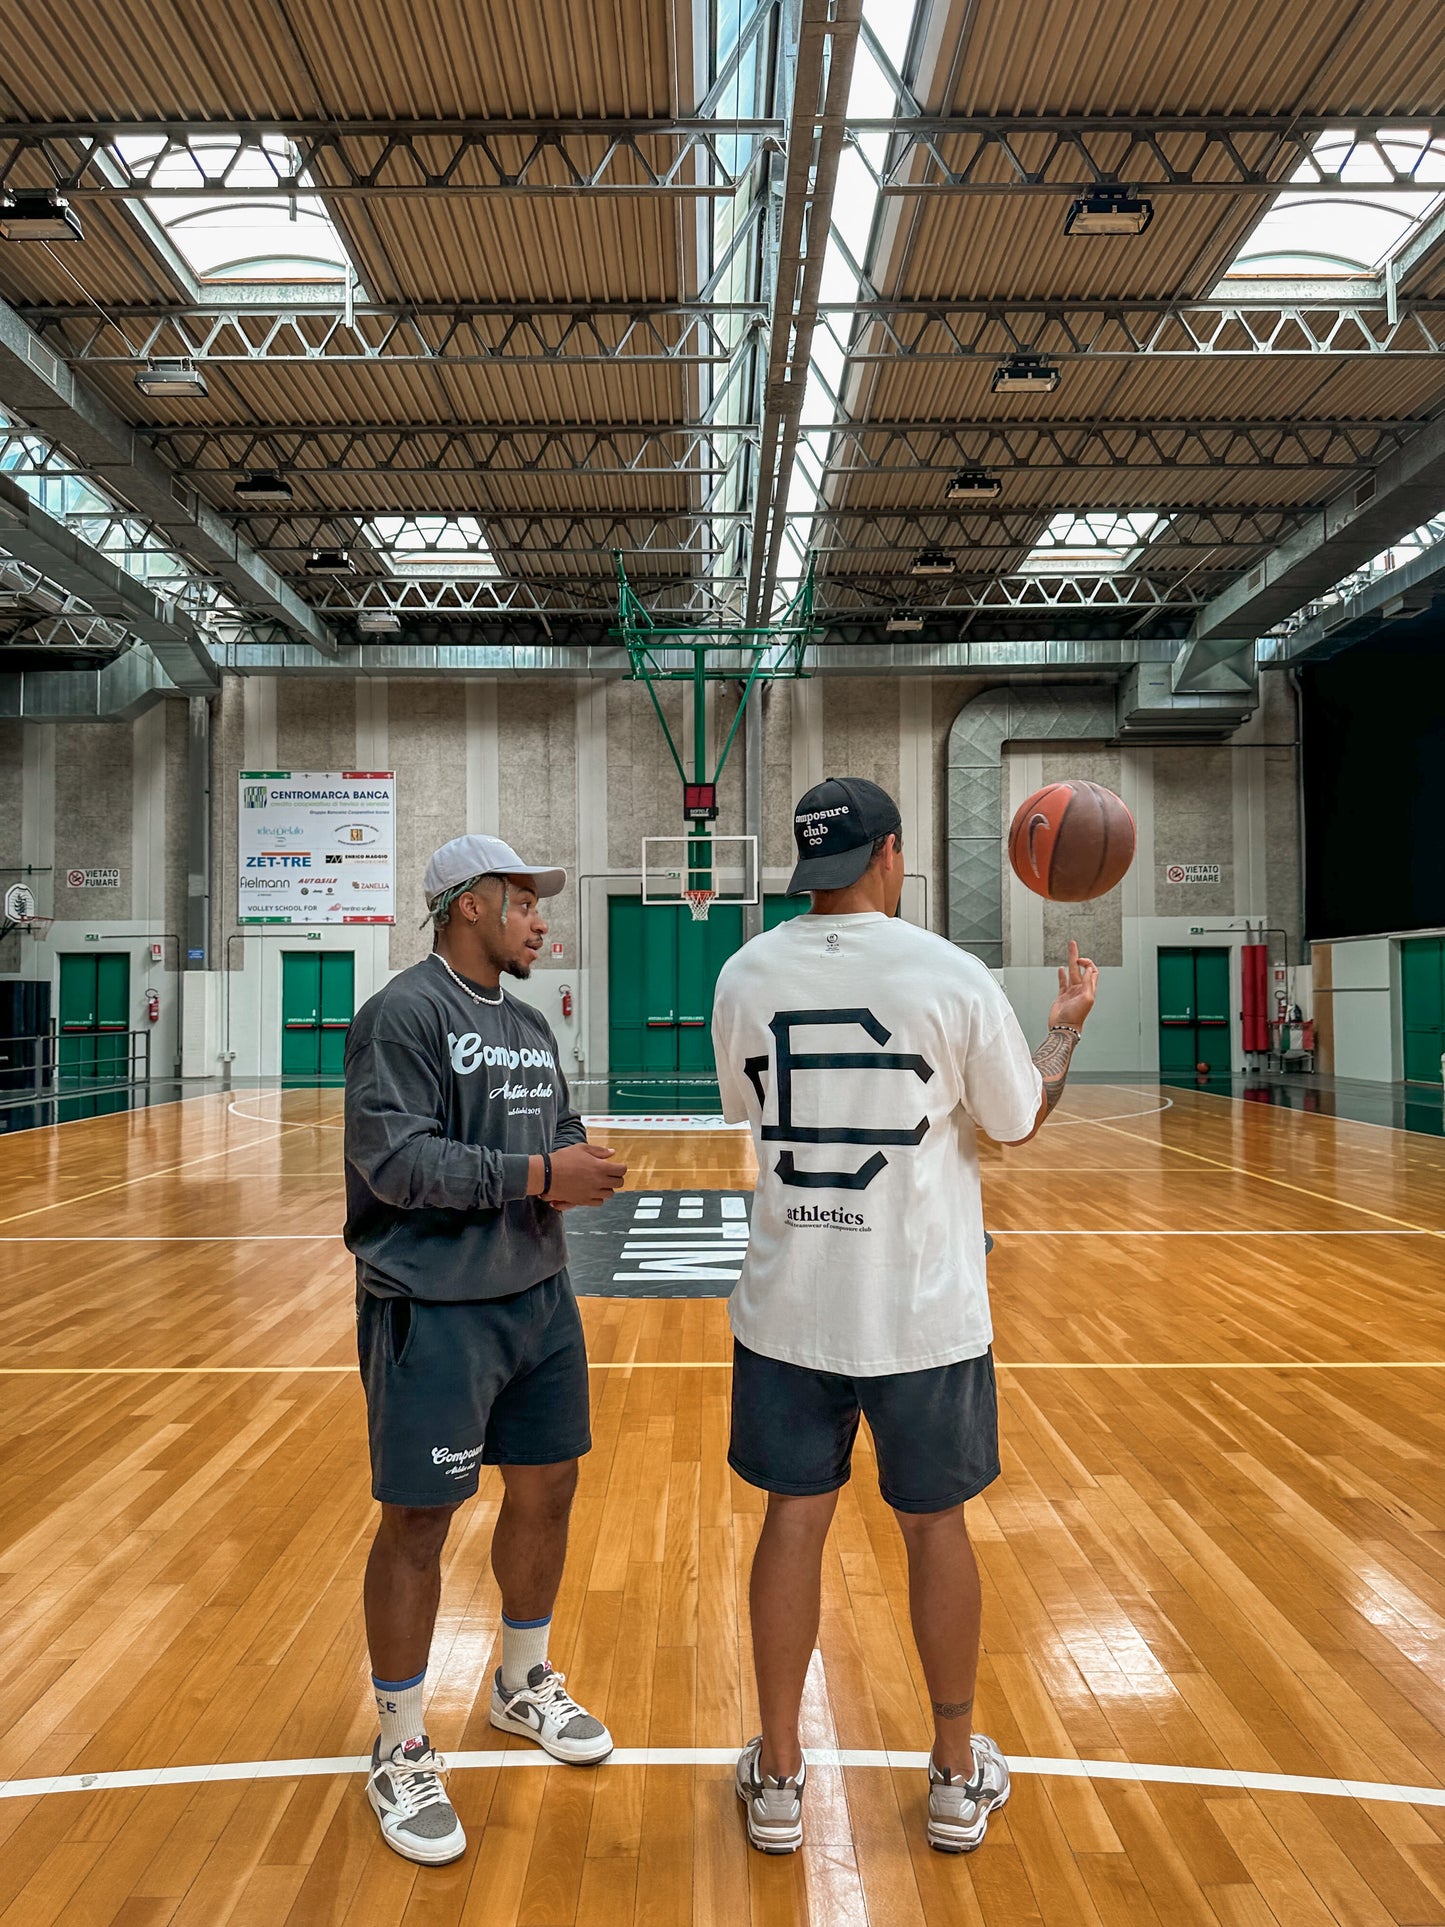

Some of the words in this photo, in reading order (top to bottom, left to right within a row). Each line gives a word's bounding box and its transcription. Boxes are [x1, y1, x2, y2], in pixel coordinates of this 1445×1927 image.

[270, 790, 350, 800] CENTROMARCA
[353, 790, 389, 800] BANCA
[795, 805, 850, 825] omposure
[803, 824, 829, 838] club
[246, 856, 312, 868] ZET-TRE
[85, 869, 119, 878] VIETATO
[1185, 865, 1219, 874] VIETATO
[85, 878, 119, 887] FUMARE
[1185, 874, 1219, 882] FUMARE
[447, 1032, 556, 1075] Composu
[530, 1082, 553, 1098] club
[787, 1205, 864, 1225] athletics
